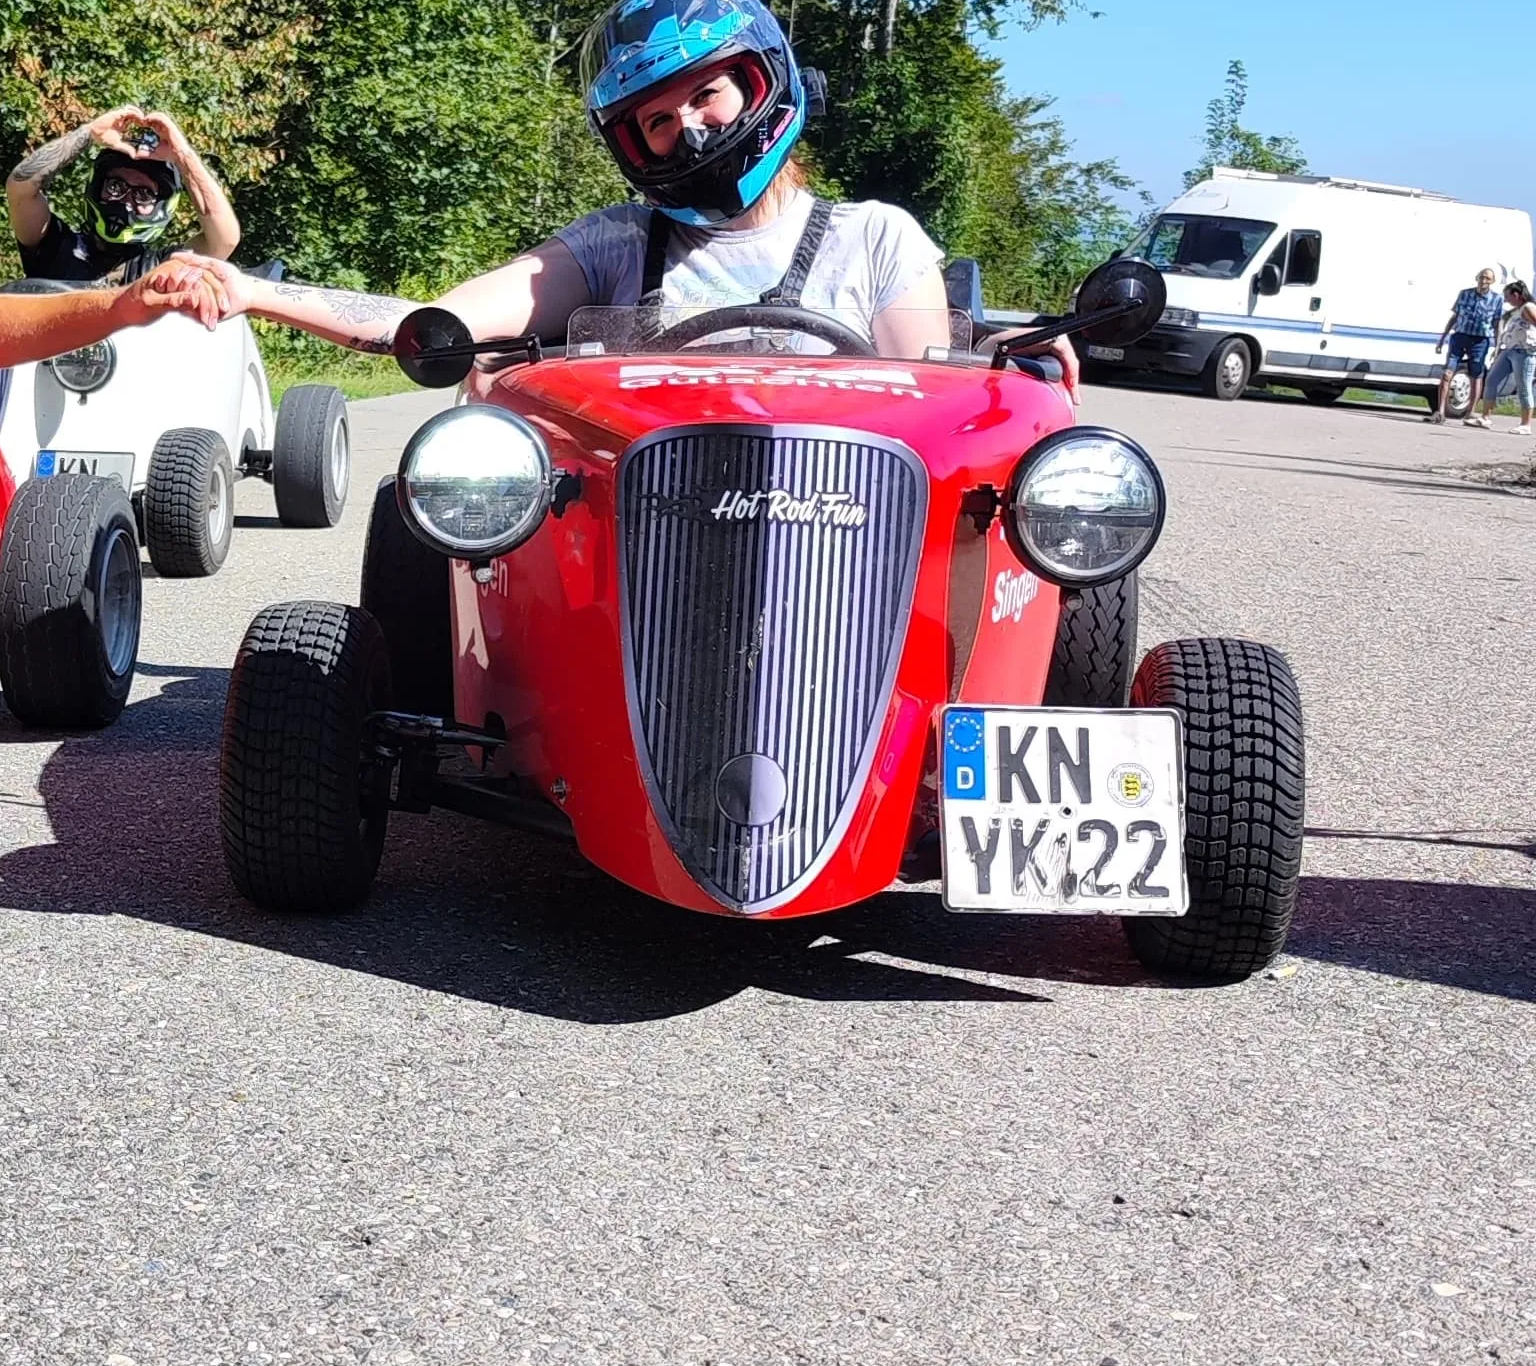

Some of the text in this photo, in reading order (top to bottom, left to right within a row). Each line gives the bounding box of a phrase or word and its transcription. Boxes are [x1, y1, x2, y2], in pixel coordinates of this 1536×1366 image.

[711, 490, 868, 527] Hot Rod Fun
[991, 568, 1039, 624] Singen
[956, 766, 975, 790] D
[996, 725, 1092, 804] KN
